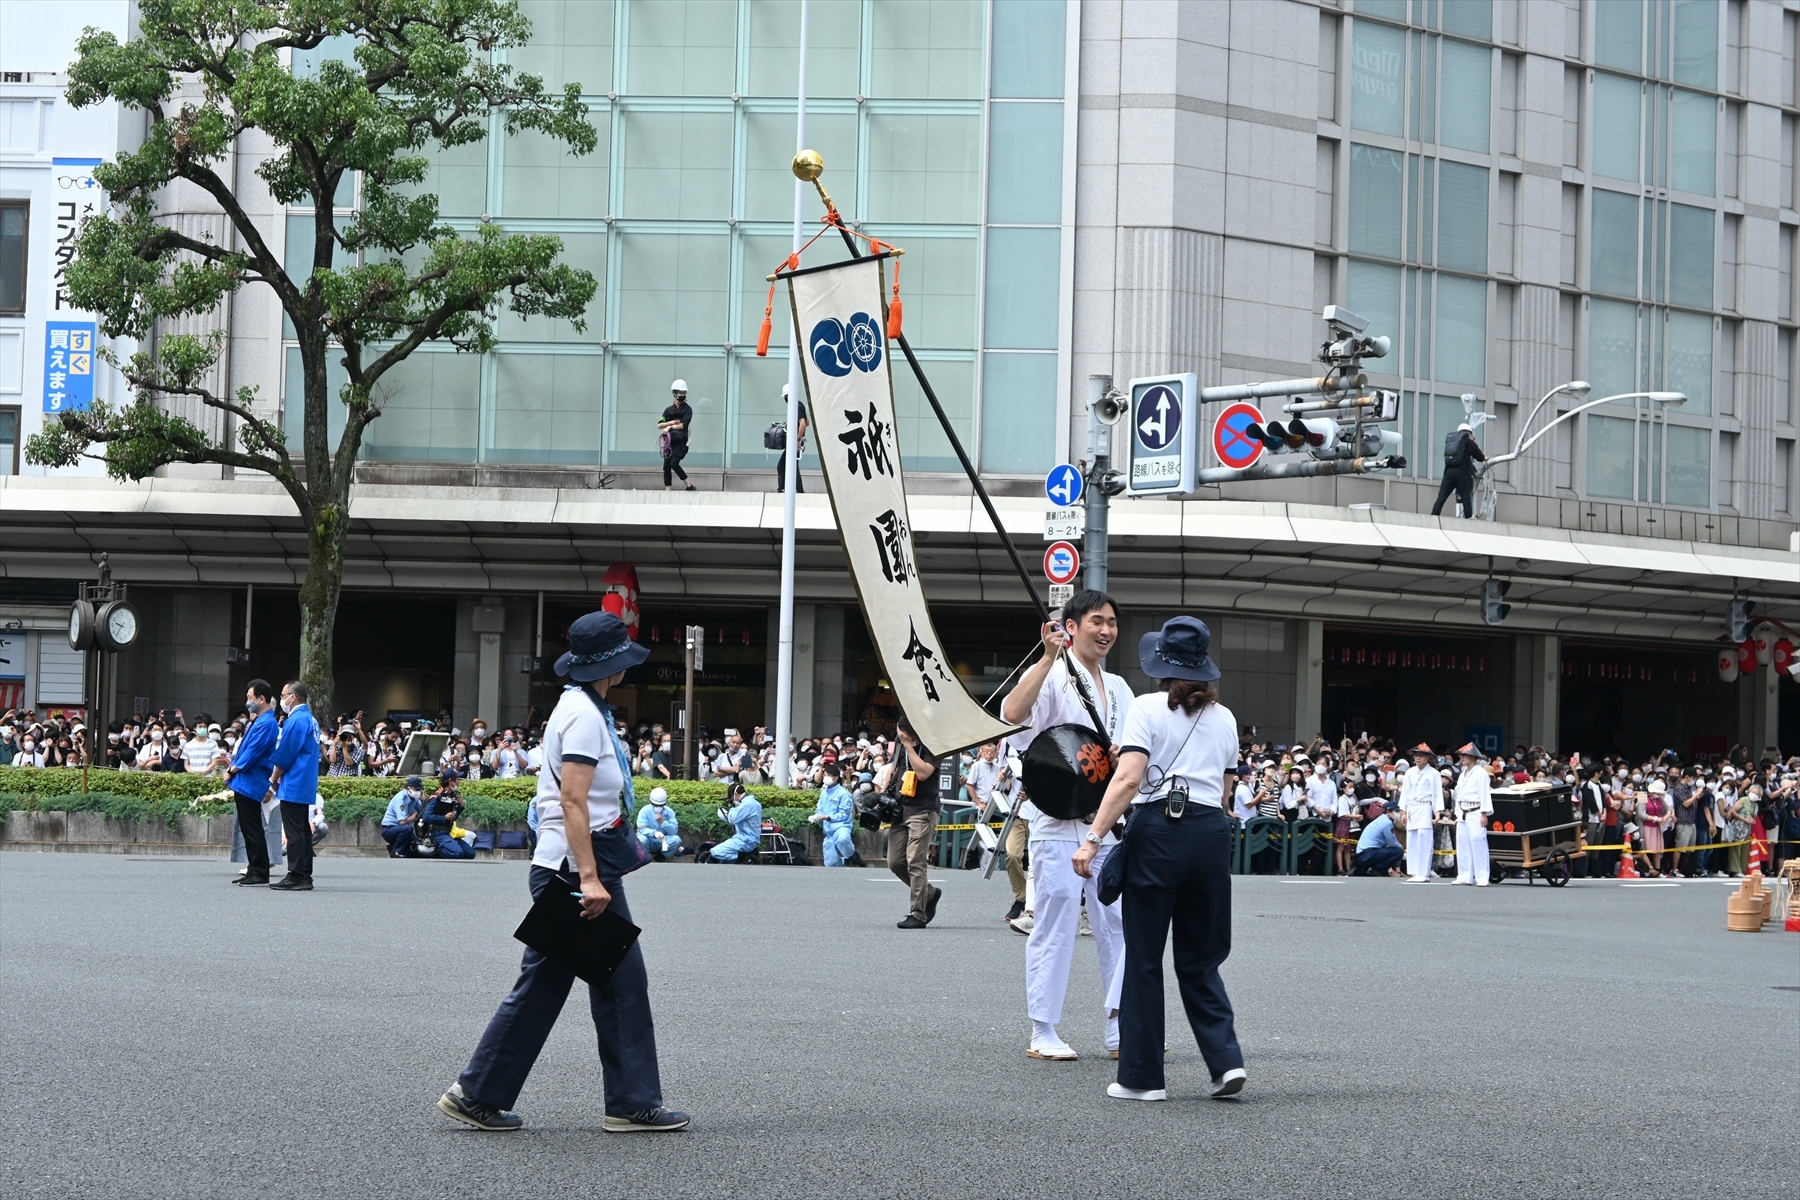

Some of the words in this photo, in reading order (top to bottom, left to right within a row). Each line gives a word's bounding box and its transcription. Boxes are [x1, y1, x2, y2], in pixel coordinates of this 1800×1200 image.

[71, 331, 88, 374] すぐ
[48, 329, 69, 411] 買えます
[1134, 461, 1181, 478] 路線バスを除く
[1046, 510, 1080, 520] 路線バスを除く
[672, 669, 737, 682] Tashimaya
[1472, 734, 1498, 752] 入口
[638, 1106, 661, 1123] N
